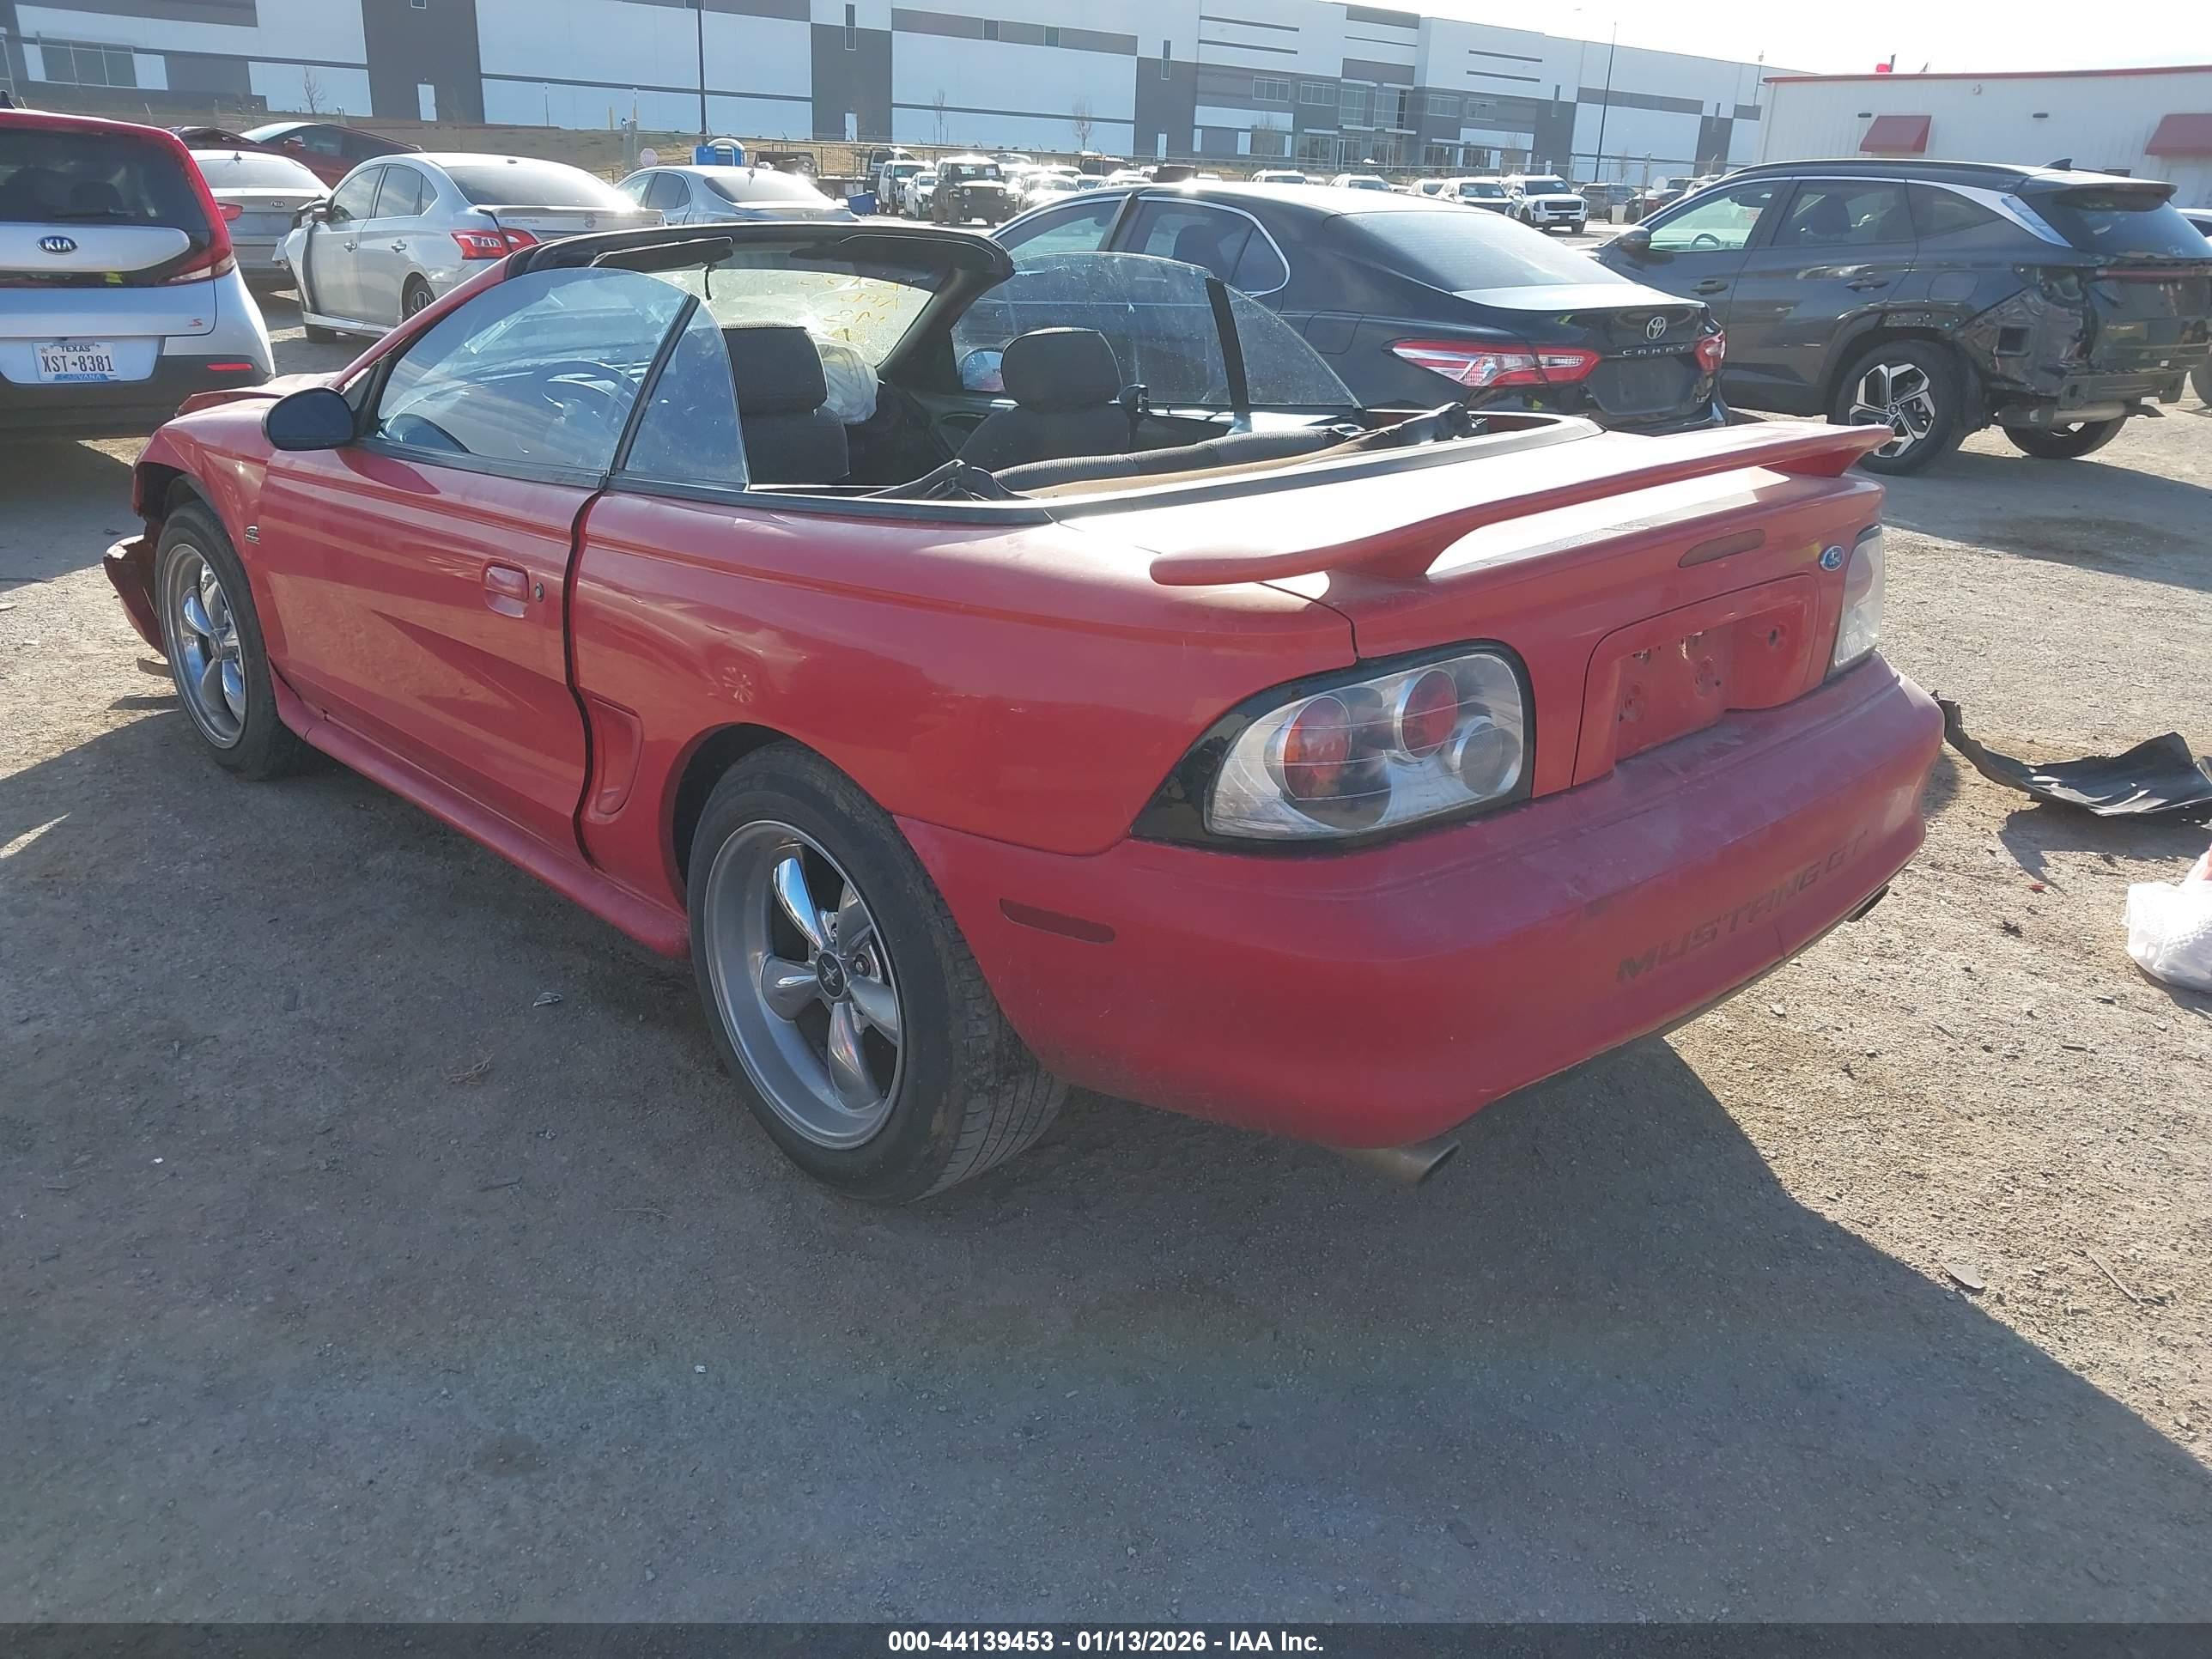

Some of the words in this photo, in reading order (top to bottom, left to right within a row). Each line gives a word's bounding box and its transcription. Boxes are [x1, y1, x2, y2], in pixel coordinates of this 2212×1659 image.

[44, 239, 73, 250] KIA
[1622, 345, 1685, 356] CAMRY
[1617, 861, 1821, 981] MUSTANG
